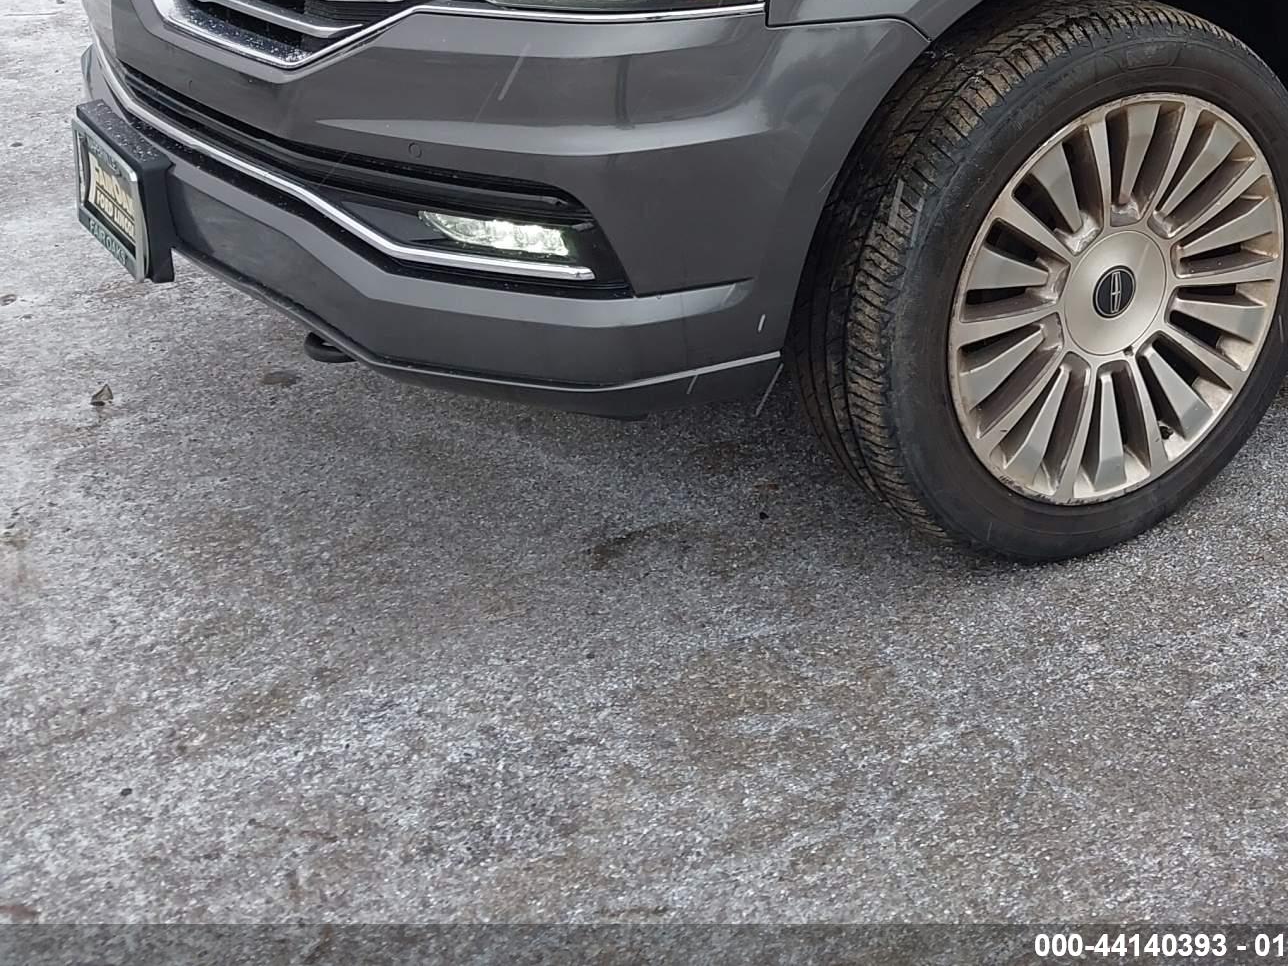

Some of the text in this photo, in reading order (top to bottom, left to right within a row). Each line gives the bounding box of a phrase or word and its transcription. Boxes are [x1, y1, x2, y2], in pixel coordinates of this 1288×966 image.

[97, 190, 113, 217] FORD
[89, 220, 127, 265] FAIR OAKS
